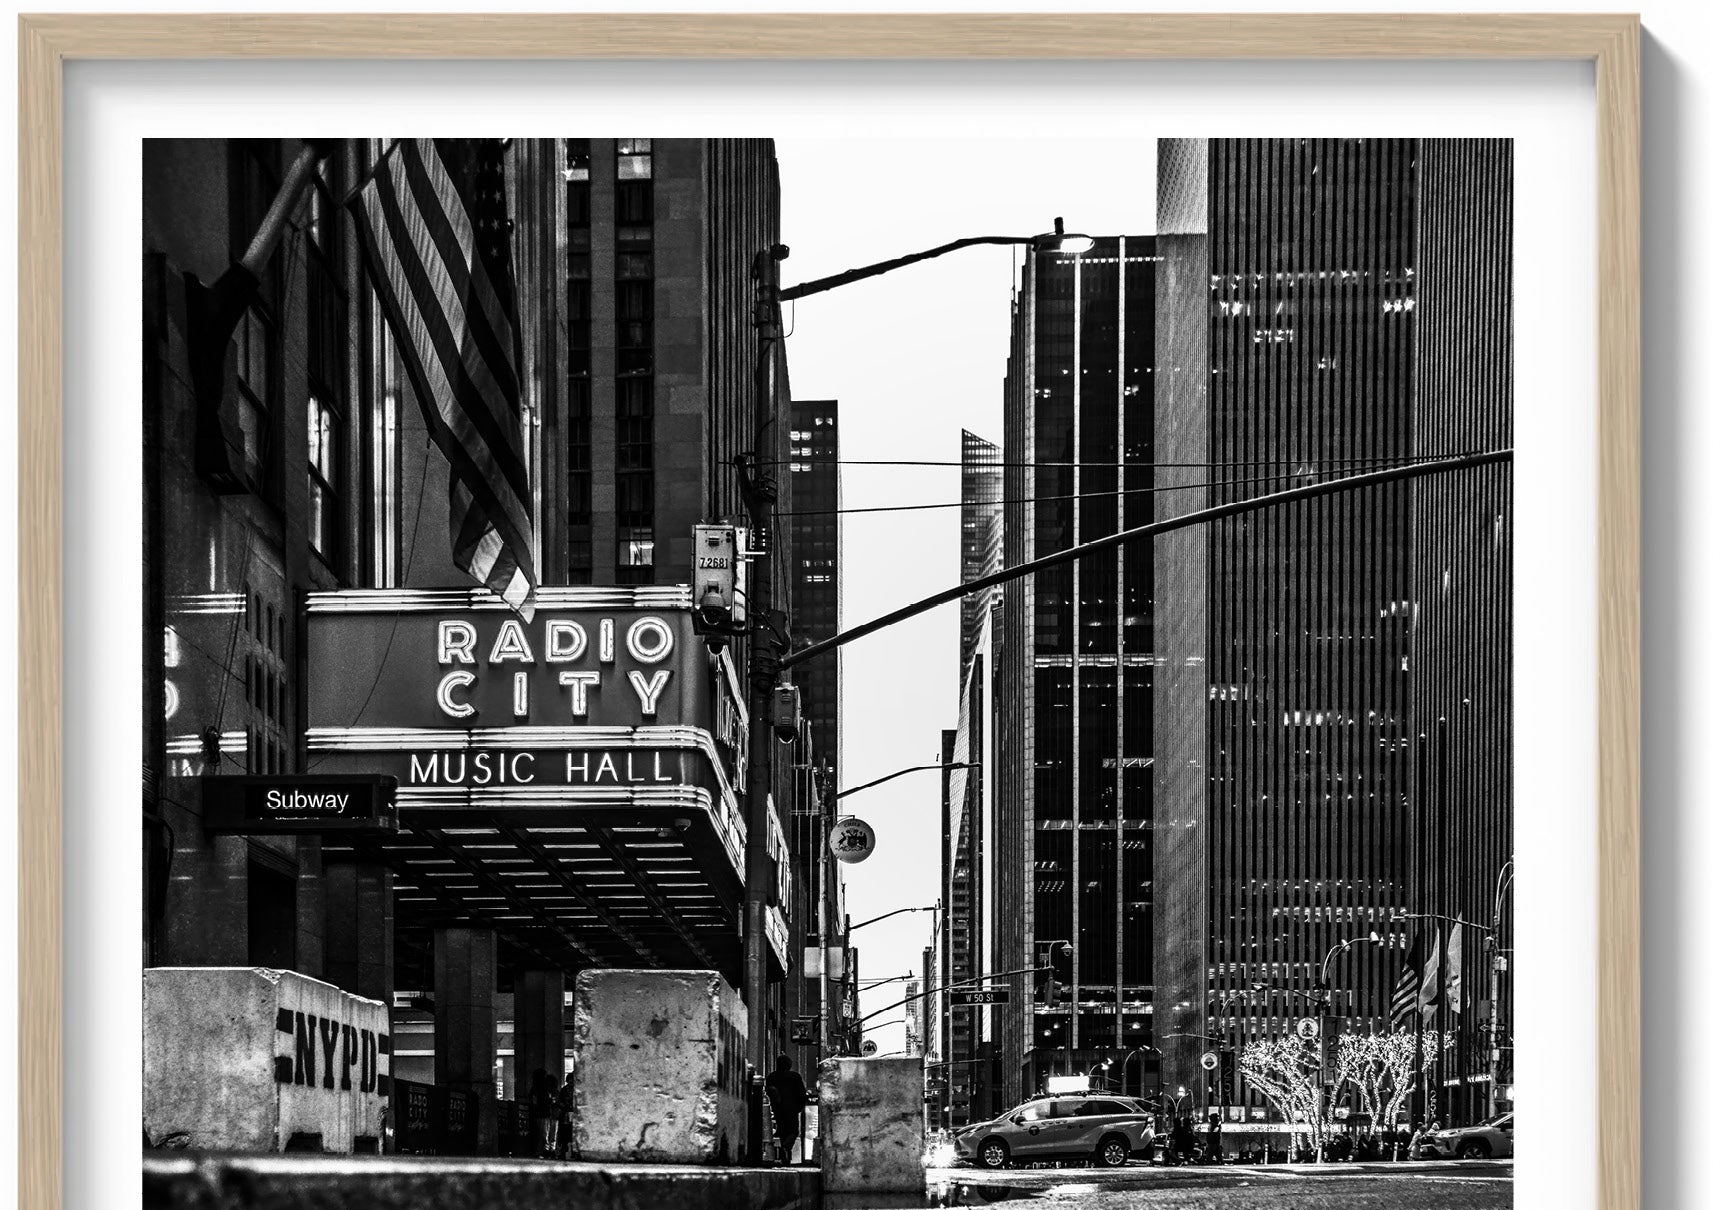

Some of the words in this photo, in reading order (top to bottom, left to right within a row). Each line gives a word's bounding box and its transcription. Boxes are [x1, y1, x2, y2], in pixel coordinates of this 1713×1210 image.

[437, 616, 675, 664] RADIO
[436, 670, 672, 718] CITY
[410, 751, 536, 784] MUSIC
[566, 751, 673, 783] HALL
[266, 789, 349, 814] Subway
[965, 994, 972, 1003] W
[974, 993, 984, 1003] 50
[986, 993, 994, 1002] St
[295, 1010, 377, 1093] NYPD
